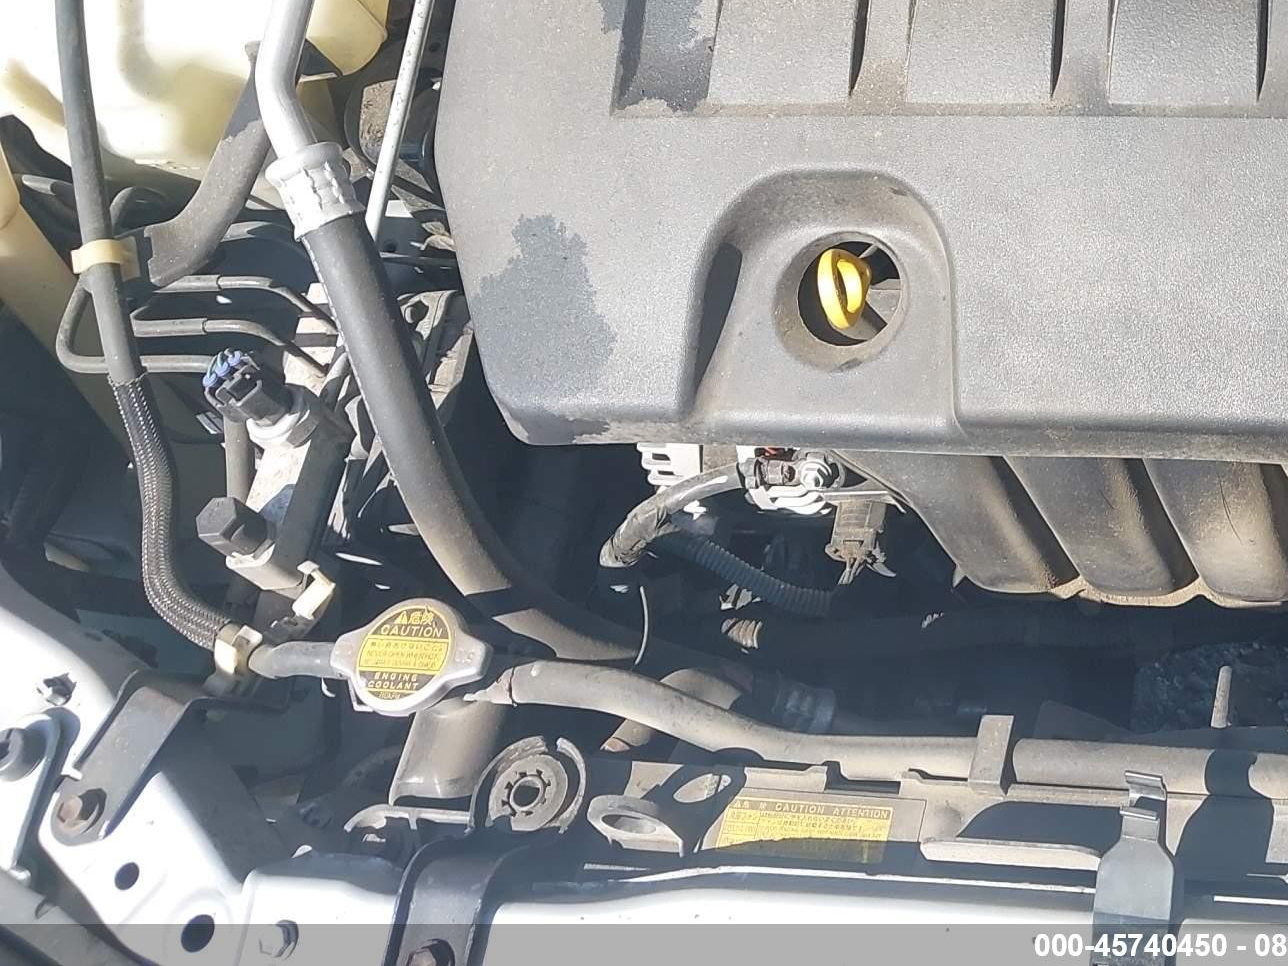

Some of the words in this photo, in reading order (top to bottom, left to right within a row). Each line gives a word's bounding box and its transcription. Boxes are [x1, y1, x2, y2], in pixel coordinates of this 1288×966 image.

[381, 625, 442, 637] CAUTION
[375, 672, 418, 681] ENGINE
[368, 680, 419, 690] COOLANT
[775, 803, 825, 814] CAUTION
[833, 808, 889, 819] ATTENTION
